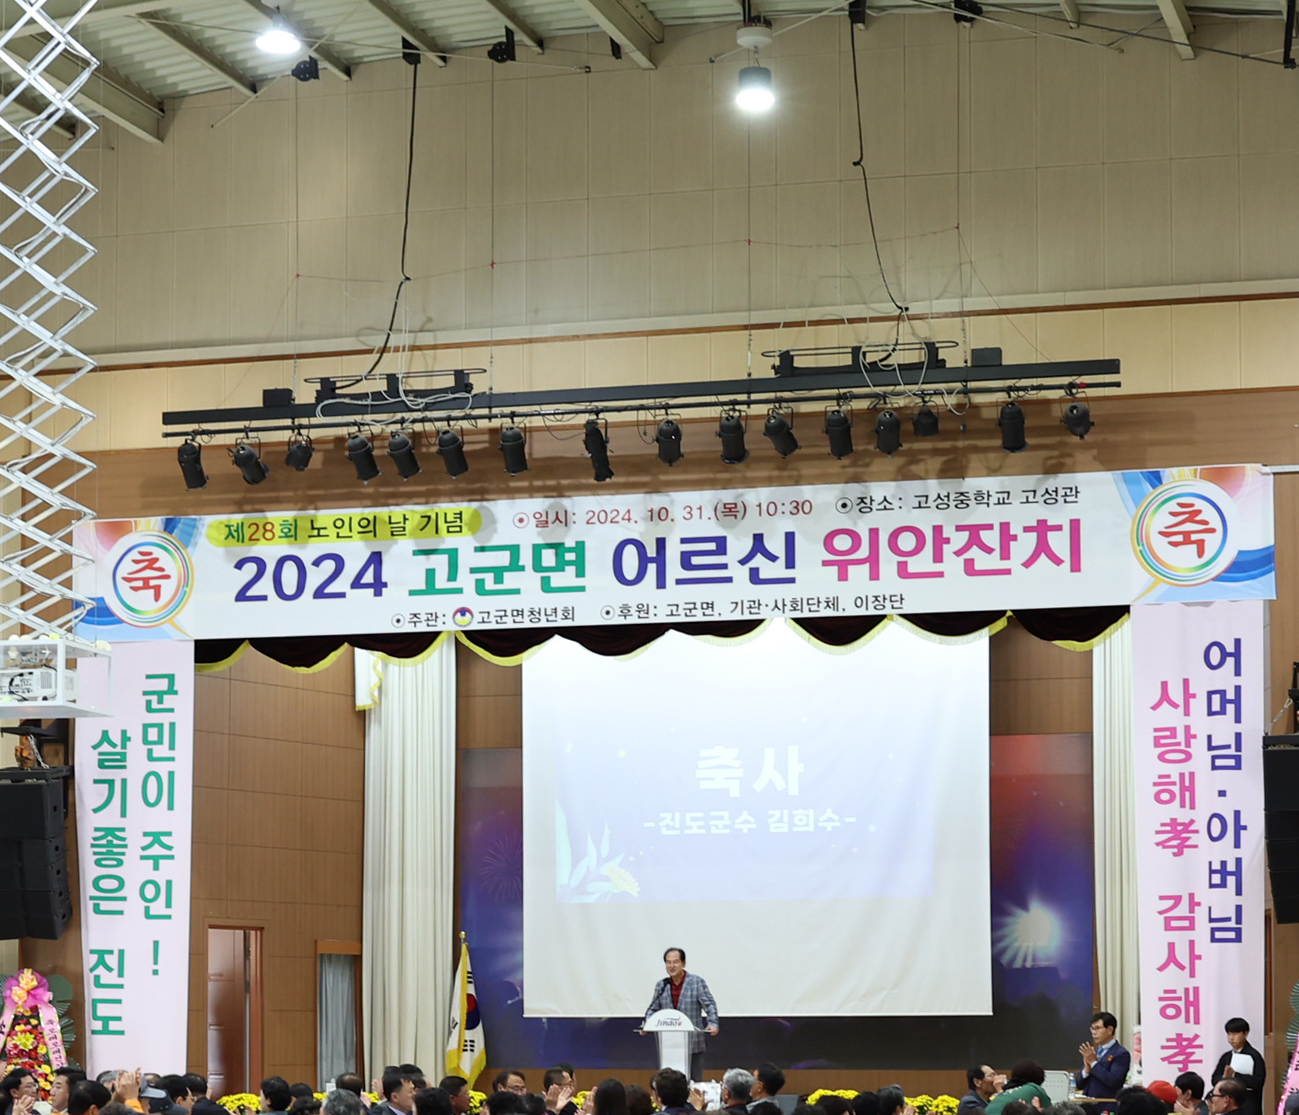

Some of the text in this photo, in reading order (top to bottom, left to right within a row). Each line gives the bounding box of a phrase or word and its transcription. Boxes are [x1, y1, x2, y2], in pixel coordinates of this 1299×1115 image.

[224, 510, 464, 544] 제28회 노인의 날 기념
[533, 510, 576, 528] 일시:
[585, 507, 638, 526] 2024.
[647, 506, 675, 523] 10.
[756, 499, 814, 518] 10:30
[856, 485, 1081, 515] 장소: 고성중학교 고성관
[1158, 501, 1218, 560] 축
[121, 549, 172, 603] 축
[233, 518, 1083, 602] 2024 고군면 어르신 위안잔치
[408, 606, 577, 628] 주관: 고군면청년회
[618, 603, 658, 620] 후원:
[665, 600, 721, 618] 고군면,
[855, 593, 905, 611] 이장단
[141, 673, 179, 811] 군민이
[89, 729, 132, 1036] 살기좋은 진도
[1150, 678, 1205, 1074] 사랑해孝 감사해孝
